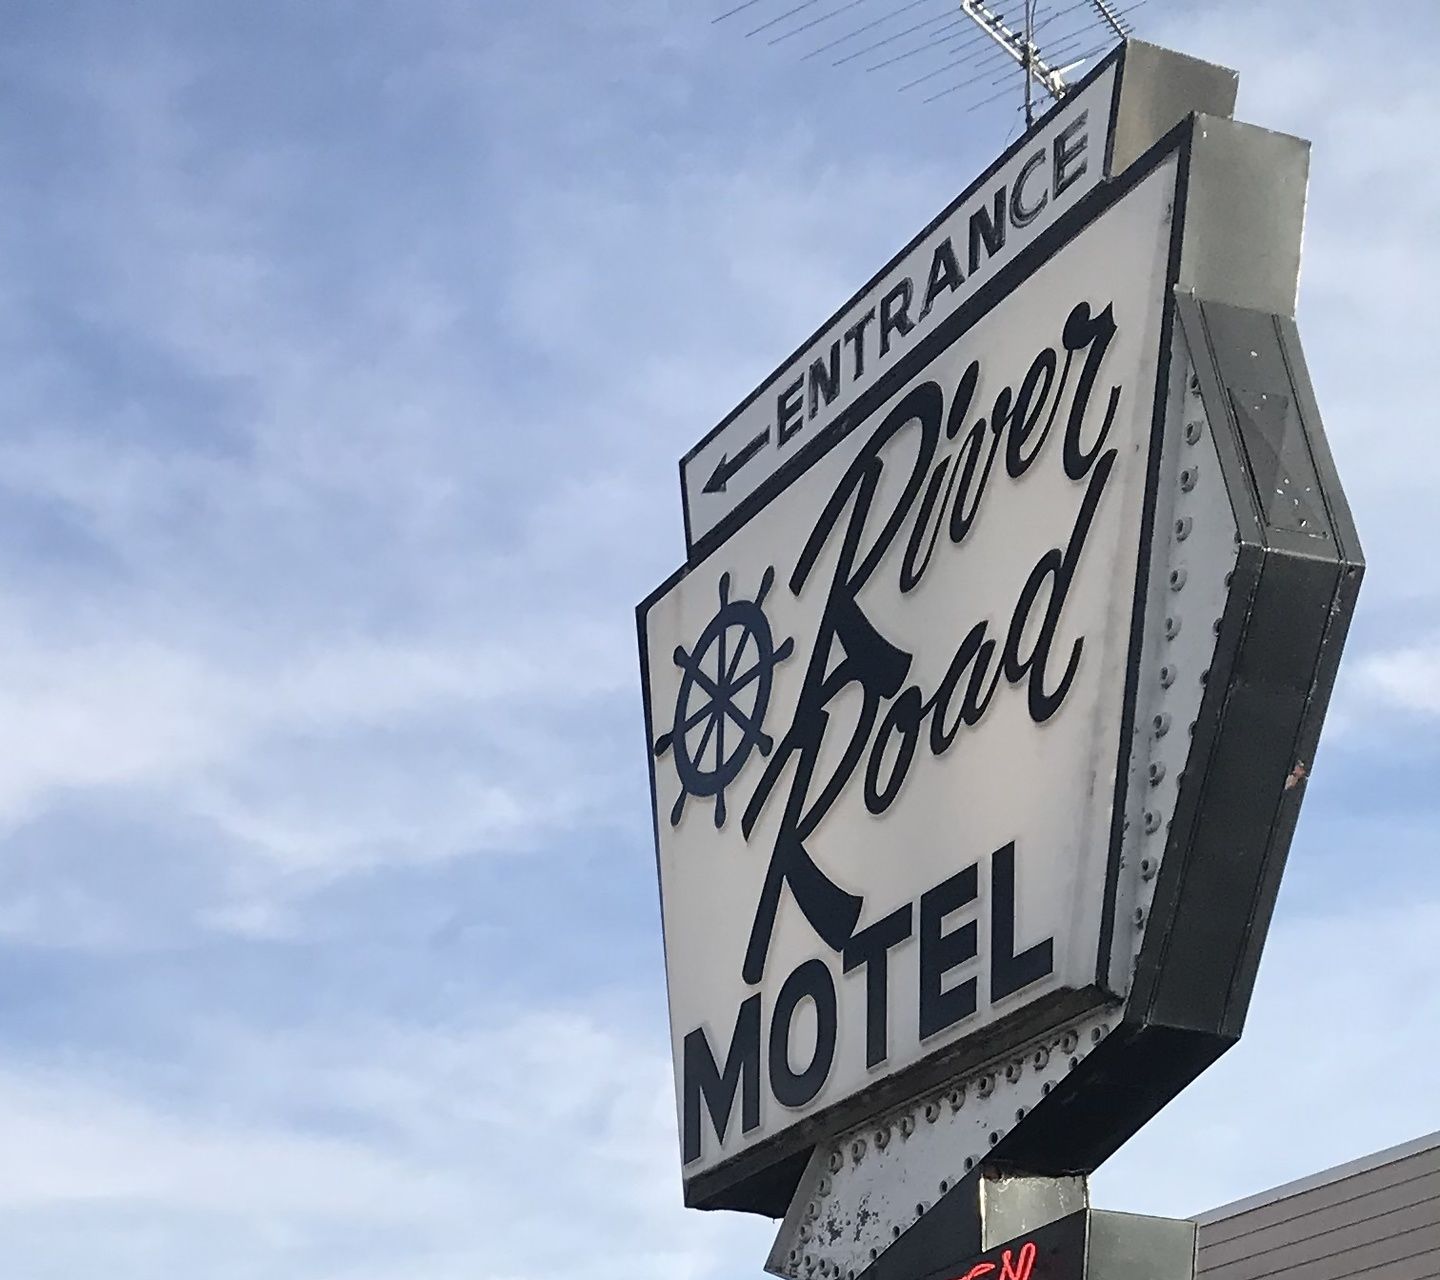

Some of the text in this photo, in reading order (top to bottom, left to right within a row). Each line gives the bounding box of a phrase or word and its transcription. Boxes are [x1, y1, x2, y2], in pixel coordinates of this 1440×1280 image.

[777, 108, 1089, 449] ENTRANCE
[789, 302, 1122, 738] River
[741, 449, 1118, 985] Road
[684, 841, 1053, 1165] MOTEL
